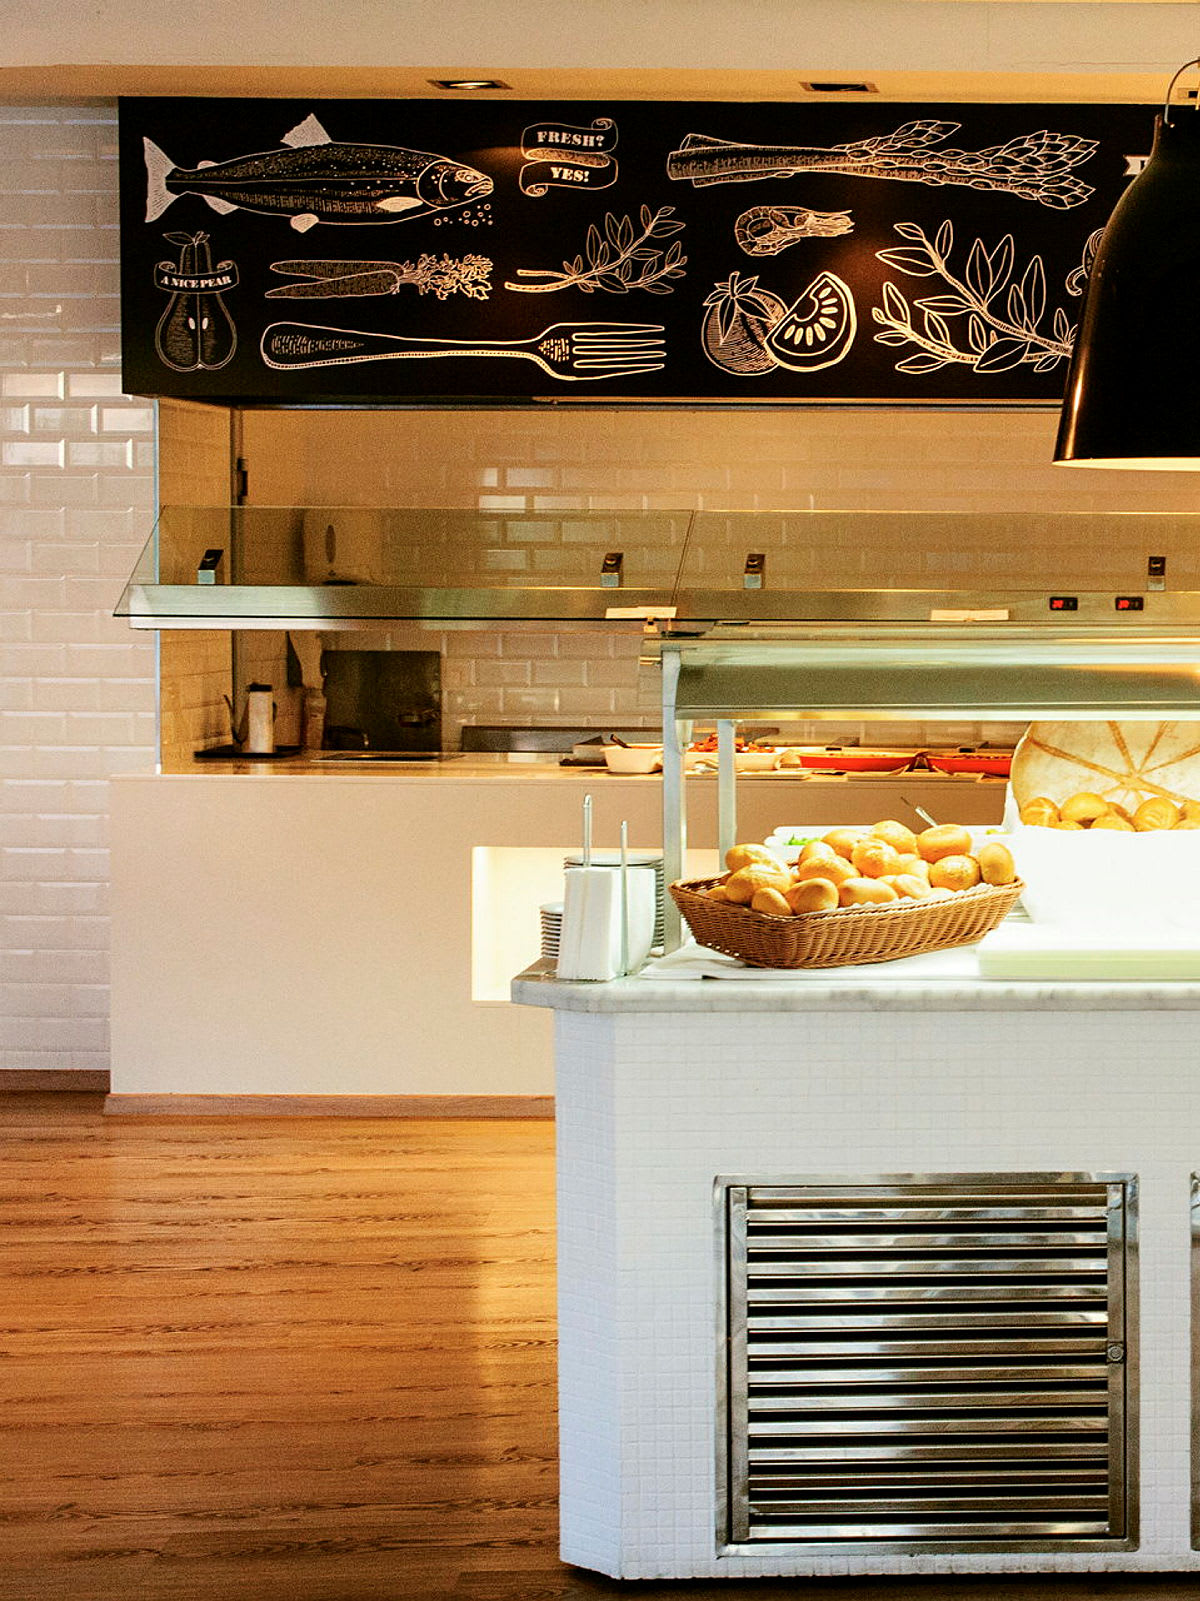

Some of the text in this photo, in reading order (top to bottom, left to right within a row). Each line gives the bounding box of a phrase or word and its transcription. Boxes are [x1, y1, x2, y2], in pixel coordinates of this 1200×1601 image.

[537, 131, 605, 147] FRESH?
[550, 167, 590, 182] YES!
[160, 275, 232, 288] A NICE PEAR
